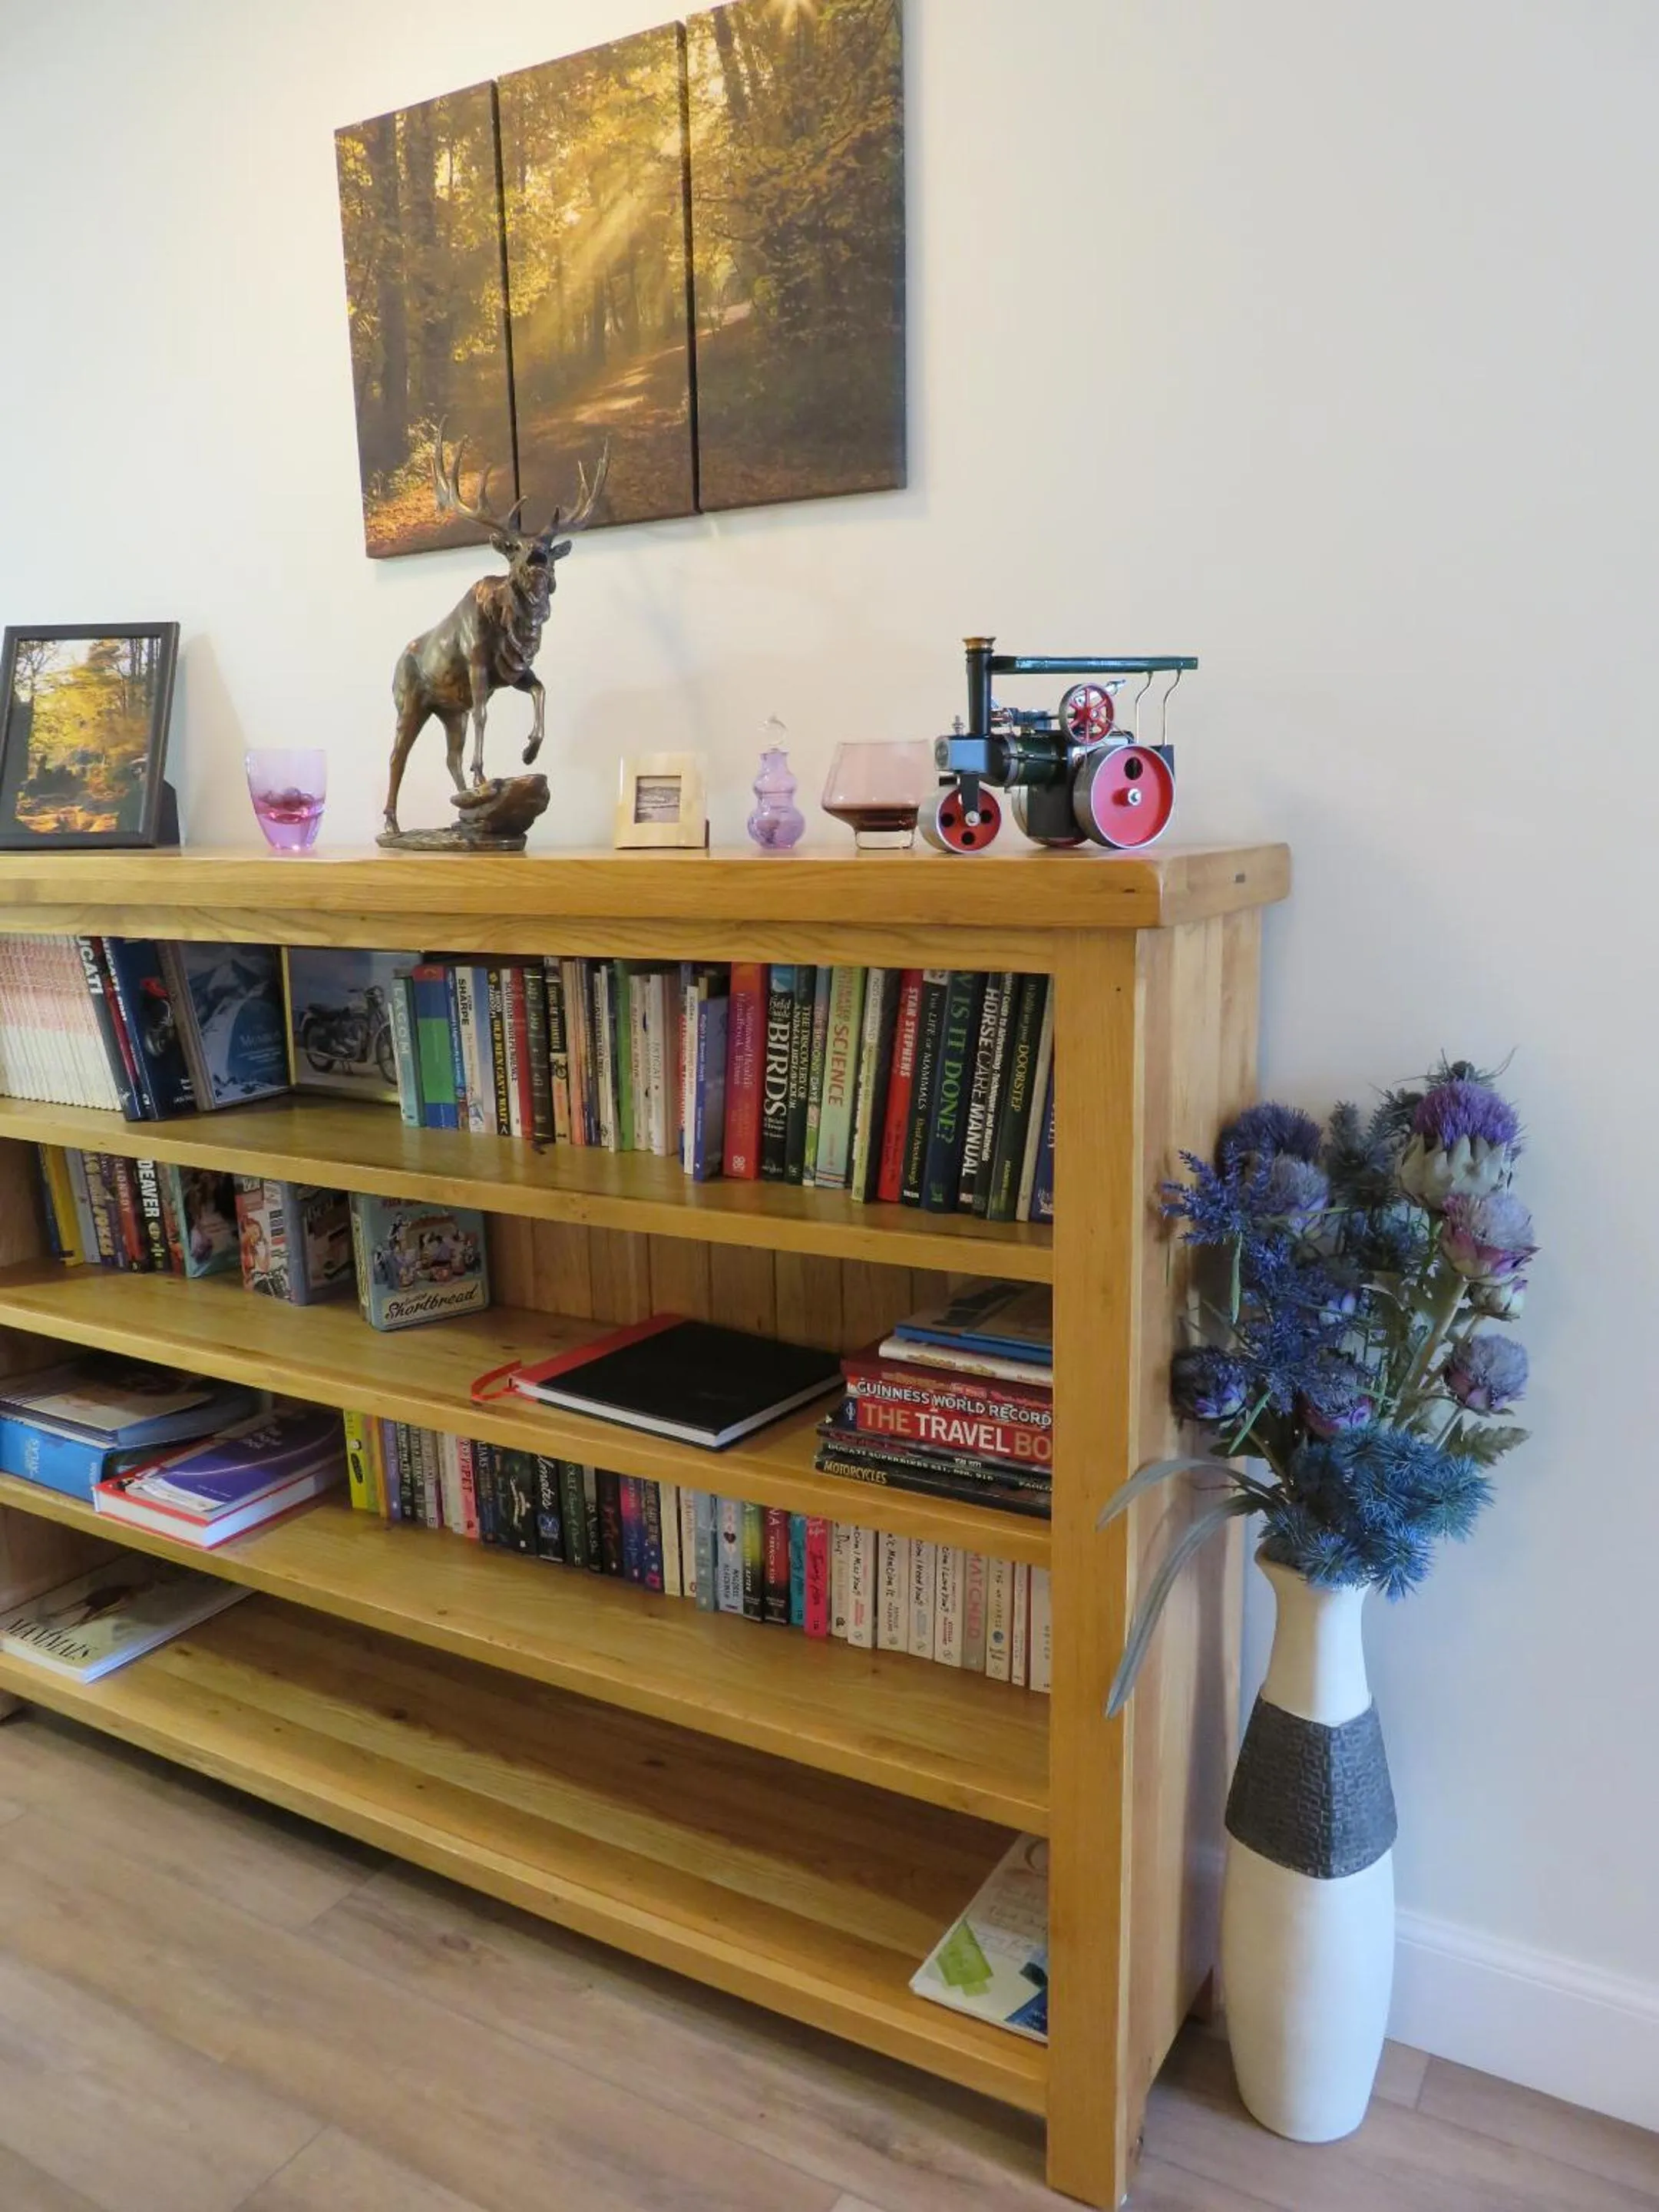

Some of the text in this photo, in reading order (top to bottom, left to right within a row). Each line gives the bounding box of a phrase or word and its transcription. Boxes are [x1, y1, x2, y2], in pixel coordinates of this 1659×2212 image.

[77, 937, 104, 995] UCATI
[394, 987, 411, 1054] LAGOM
[458, 978, 470, 1026] SHARPE
[905, 987, 919, 1016] STAN
[927, 1012, 937, 1036] LIFE
[950, 996, 970, 1019] IS
[1000, 995, 1010, 1016] Guide
[493, 1020, 502, 1040] OLD
[791, 1003, 801, 1046] ANIMAL
[947, 1027, 966, 1054] IT
[495, 1043, 504, 1066] MEN
[764, 1022, 790, 1116] BIRDS
[798, 1005, 811, 1100] THE DISCOVERY OF
[828, 1025, 850, 1108] SCIENCE
[899, 1020, 914, 1078] STEPHENS
[808, 1076, 820, 1102] DAYS
[917, 1053, 930, 1110] MAMMALS
[961, 987, 1000, 1177] HORSE CARE MANUAL
[1010, 1044, 1030, 1113] DOORSTEP
[935, 1060, 963, 1144] DONE?
[981, 1129, 993, 1162] Materials
[137, 1160, 160, 1218] DEAVER
[385, 1283, 479, 1319] Shortbread
[856, 1379, 930, 1405] GUINNESS
[933, 1392, 986, 1414] WORLD
[990, 1404, 1052, 1427] RECORD
[862, 1402, 1052, 1460] THE TRAVEL BO
[823, 1460, 888, 1485] MOTORCYCLES
[828, 1443, 867, 1457] DUCATI
[869, 1451, 928, 1469] SUPERBIKES
[886, 1550, 897, 1586] Mention
